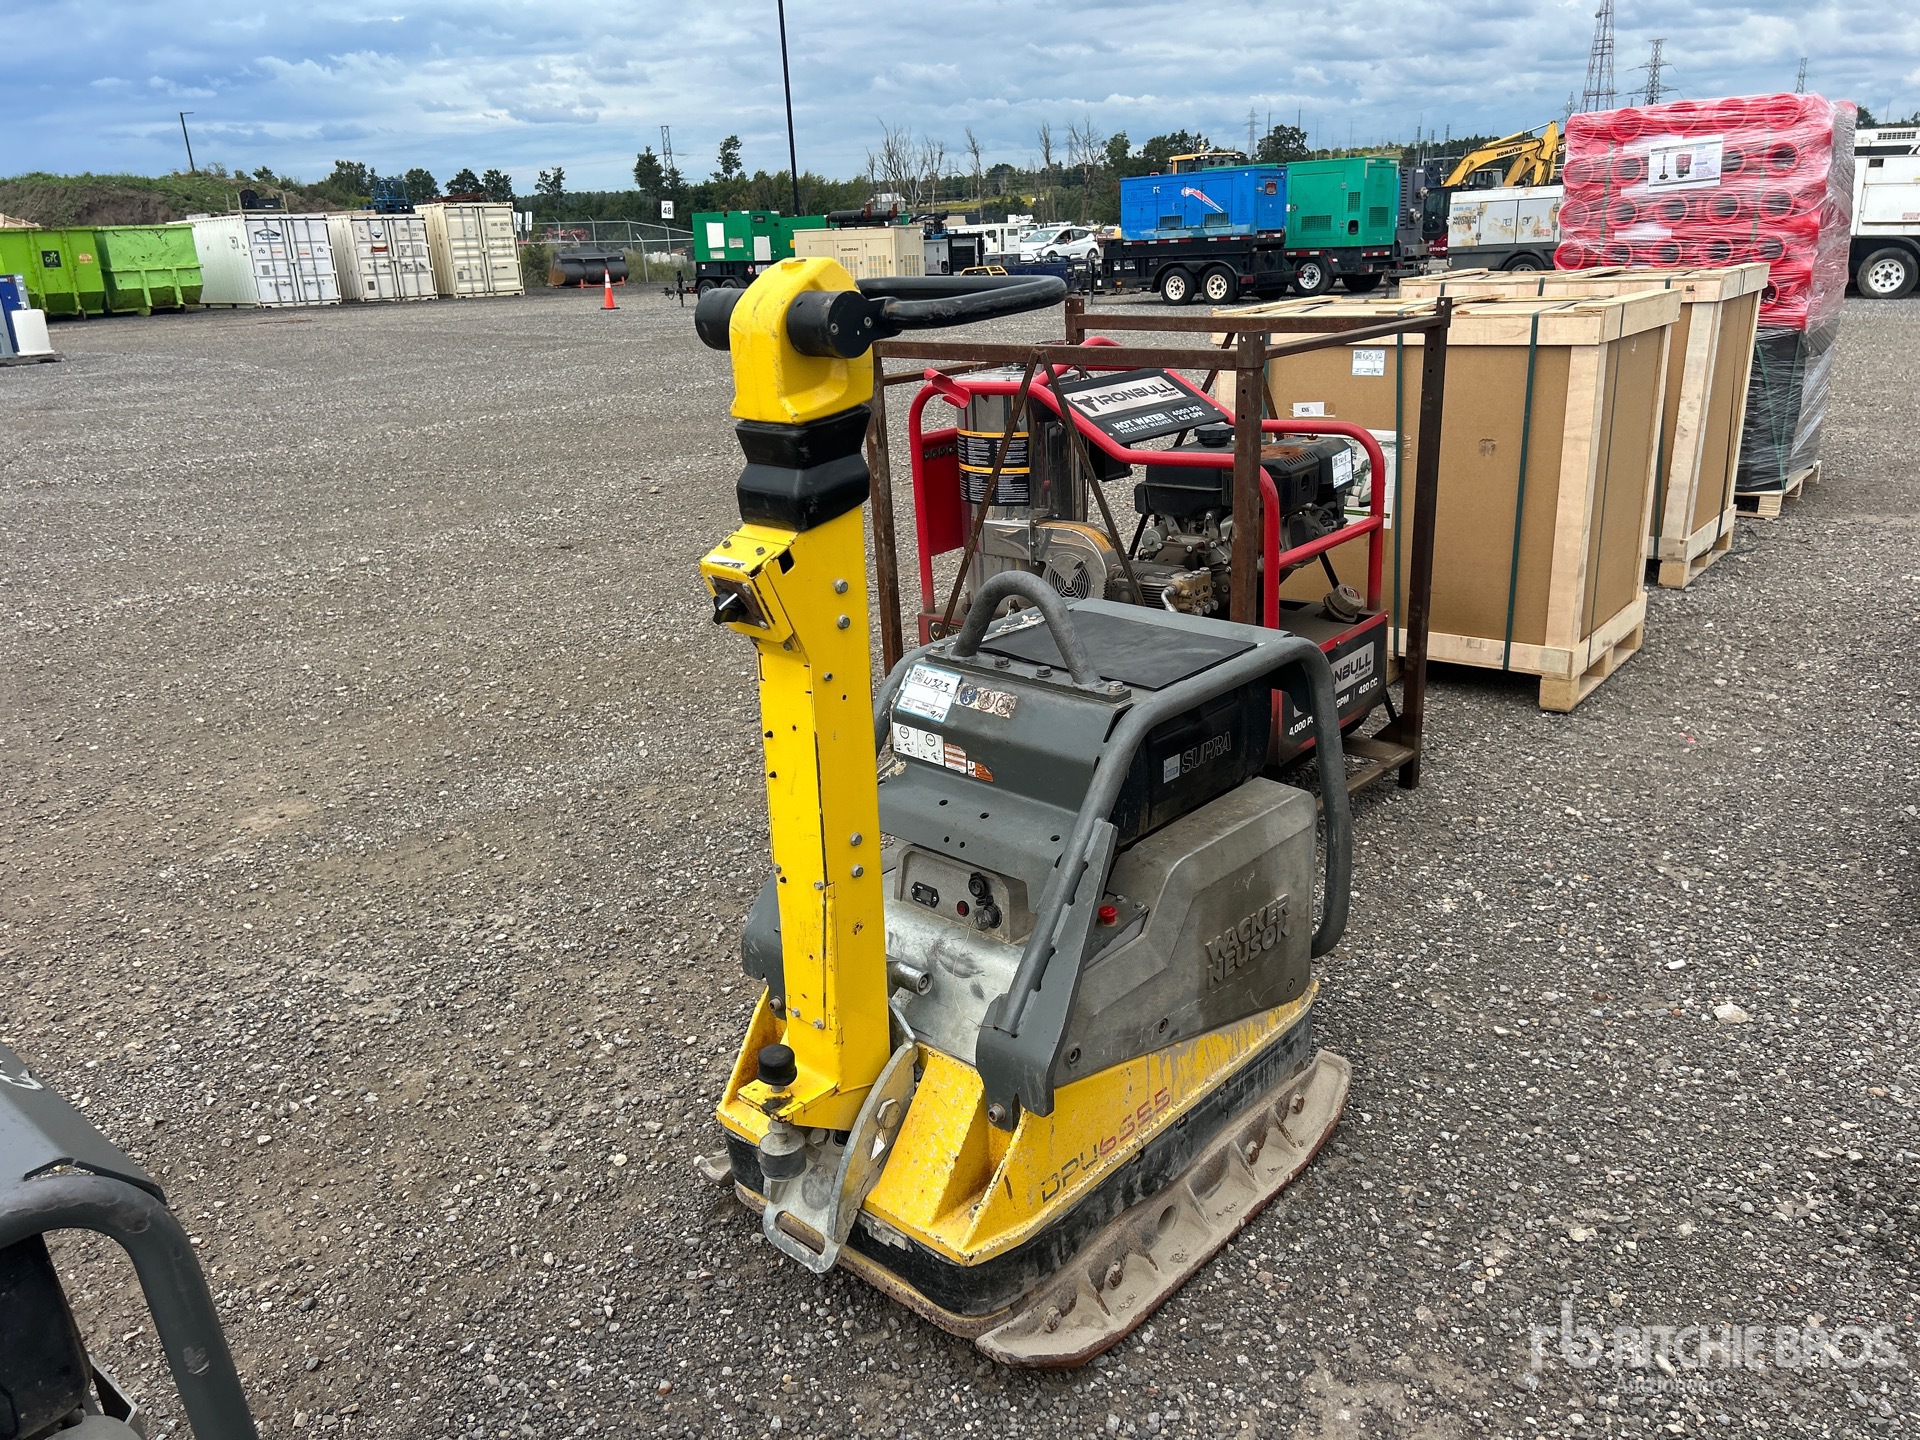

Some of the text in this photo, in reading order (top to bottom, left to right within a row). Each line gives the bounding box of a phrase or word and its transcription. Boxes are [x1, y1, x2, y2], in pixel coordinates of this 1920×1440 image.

[1496, 146, 1523, 157] KOMATSU
[663, 206, 671, 215] 48
[1093, 383, 1176, 406] IRONBULL
[1172, 407, 1191, 416] 4000
[1111, 413, 1168, 431] HOT WATER
[1120, 418, 1174, 434] PRESSURE WASHER
[1358, 682, 1370, 695] 420
[1370, 677, 1378, 688] CC
[1181, 731, 1232, 774] SUPRA
[1205, 893, 1291, 967] WACKER
[1207, 920, 1291, 990] NEUSON
